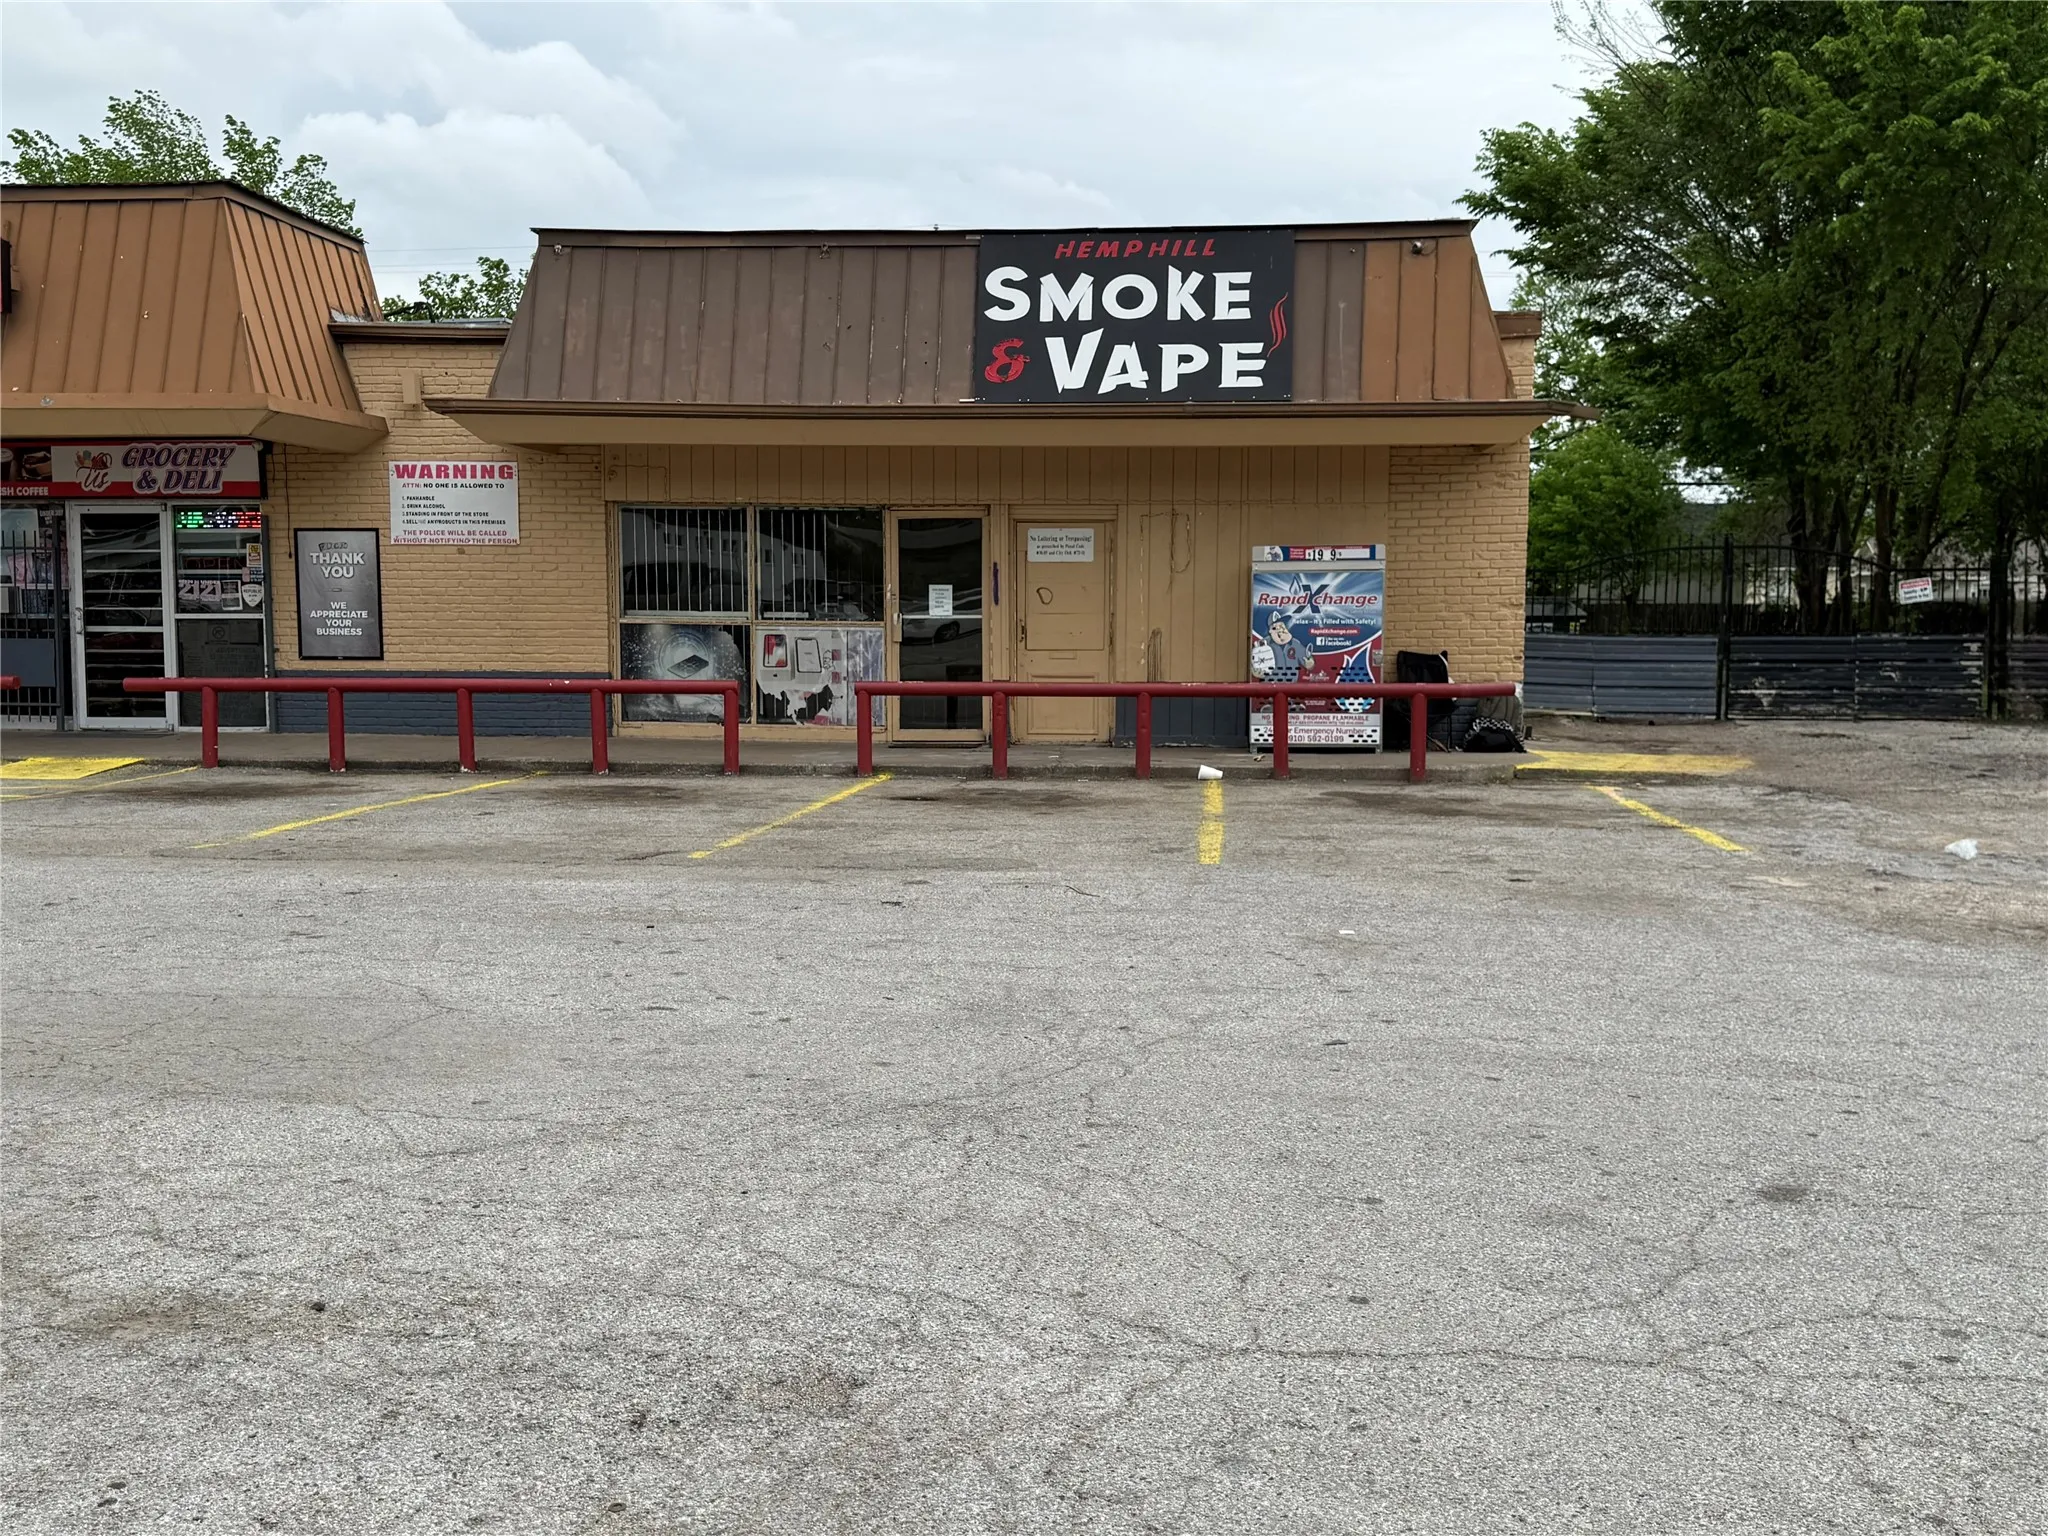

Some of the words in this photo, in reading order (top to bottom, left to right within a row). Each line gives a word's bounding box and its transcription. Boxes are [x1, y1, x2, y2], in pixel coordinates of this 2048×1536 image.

[1054, 238, 1217, 259] HEMPHILL
[984, 265, 1253, 322] SMOKE
[984, 337, 1030, 383] &
[1044, 327, 1267, 395] VAPE
[121, 446, 237, 468] GROCERY
[137, 470, 157, 490] &
[164, 470, 222, 490] DELI
[394, 464, 514, 480] WARNING
[16, 486, 48, 496] COFFEE
[310, 552, 365, 564] THANK
[322, 566, 354, 578] YOU
